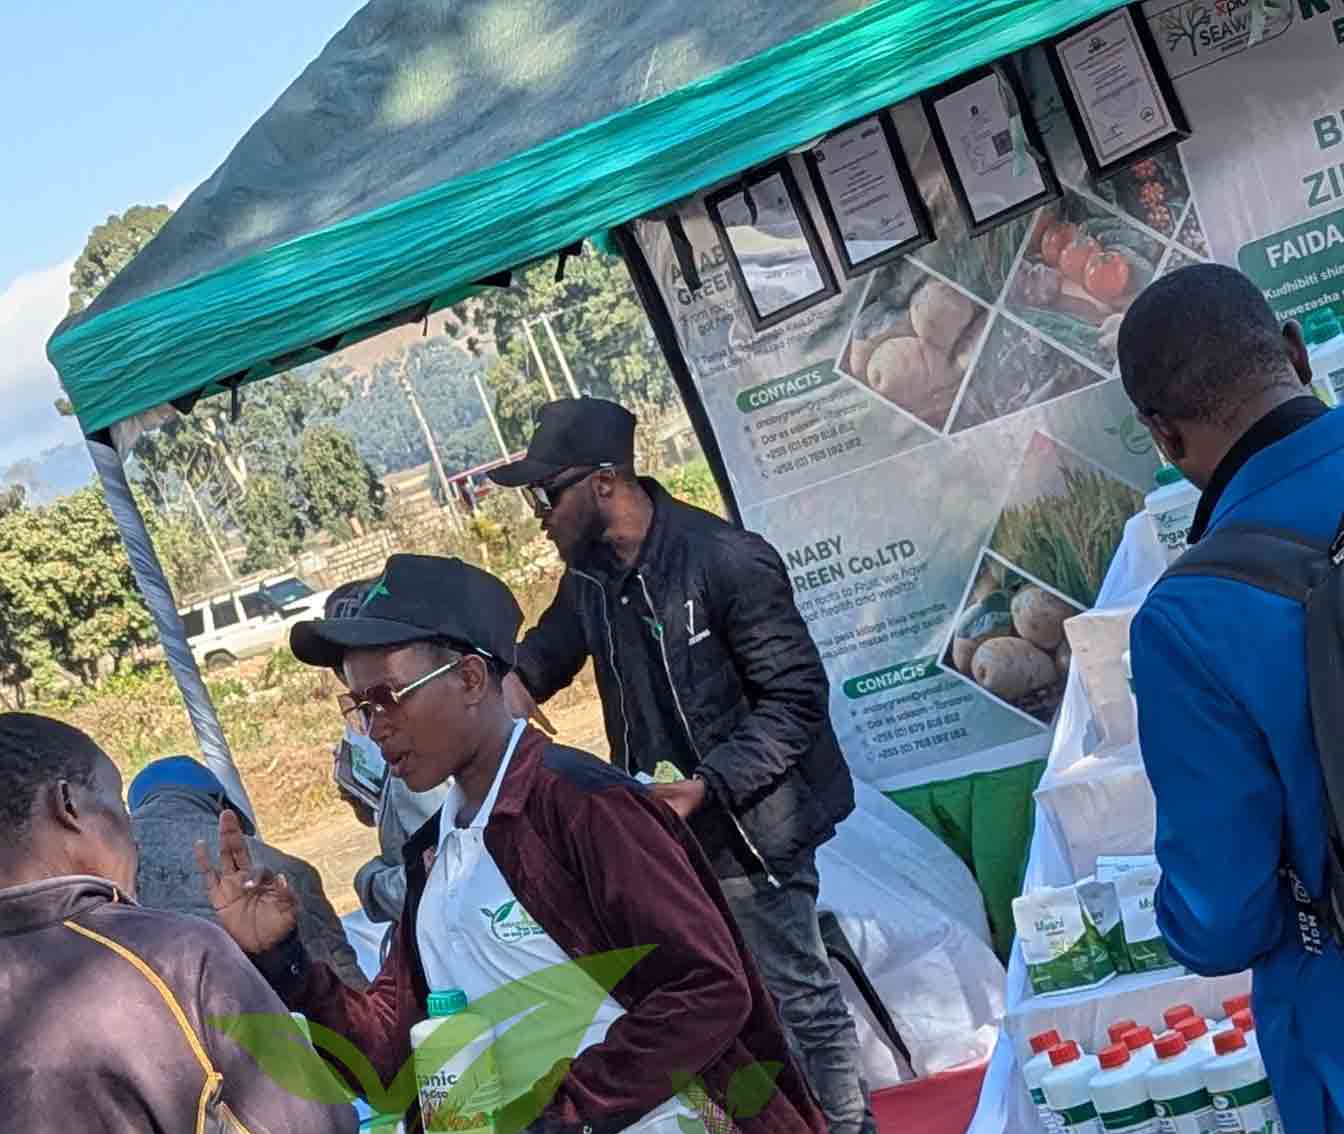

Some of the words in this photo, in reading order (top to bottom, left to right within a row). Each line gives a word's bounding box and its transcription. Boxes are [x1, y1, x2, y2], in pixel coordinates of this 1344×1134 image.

[1264, 223, 1344, 269] FAIDA
[749, 369, 823, 407] CONTACTS
[784, 535, 843, 571] NABY
[847, 538, 917, 574] Co.LTD
[856, 663, 926, 694] CONTACTS
